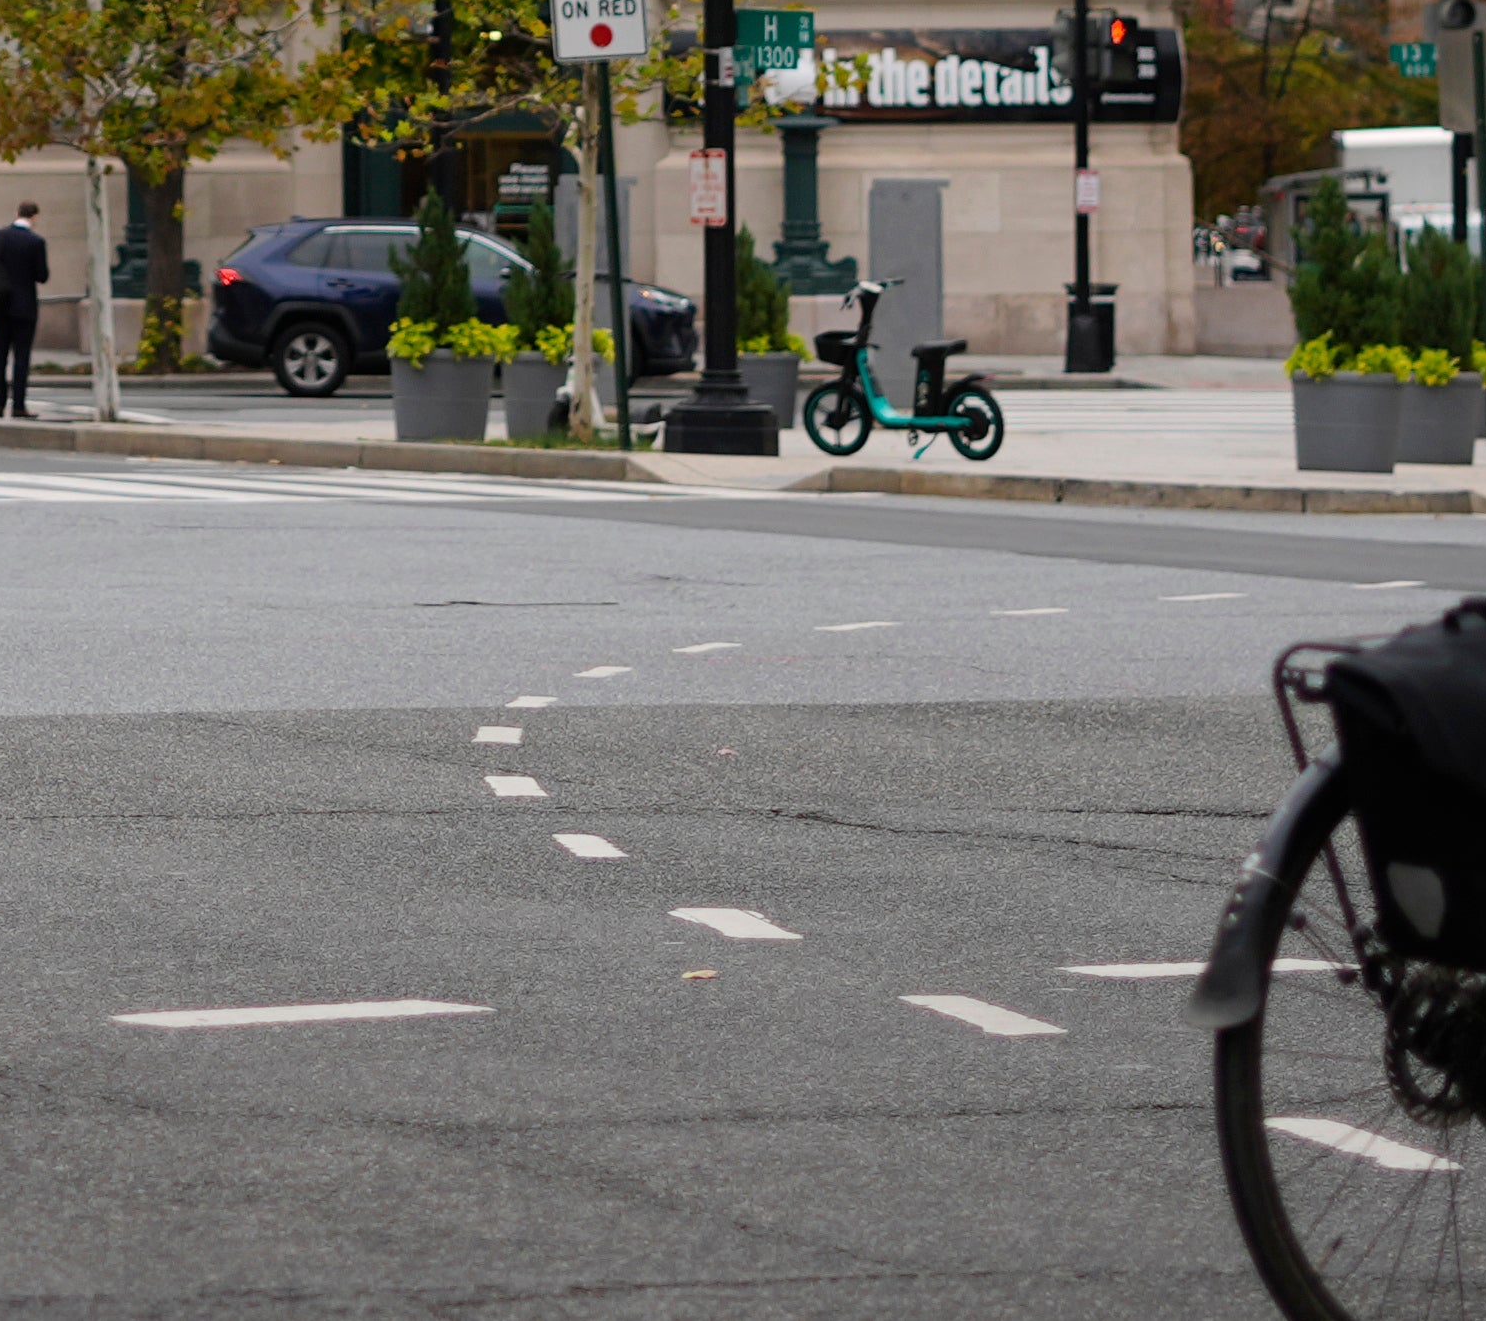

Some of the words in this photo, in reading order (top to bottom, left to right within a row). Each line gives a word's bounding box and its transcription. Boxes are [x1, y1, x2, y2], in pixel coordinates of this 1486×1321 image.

[561, 1, 589, 19] ON
[764, 14, 778, 42] H
[757, 45, 795, 68] 1300
[866, 46, 930, 107] the
[934, 45, 1074, 108] details
